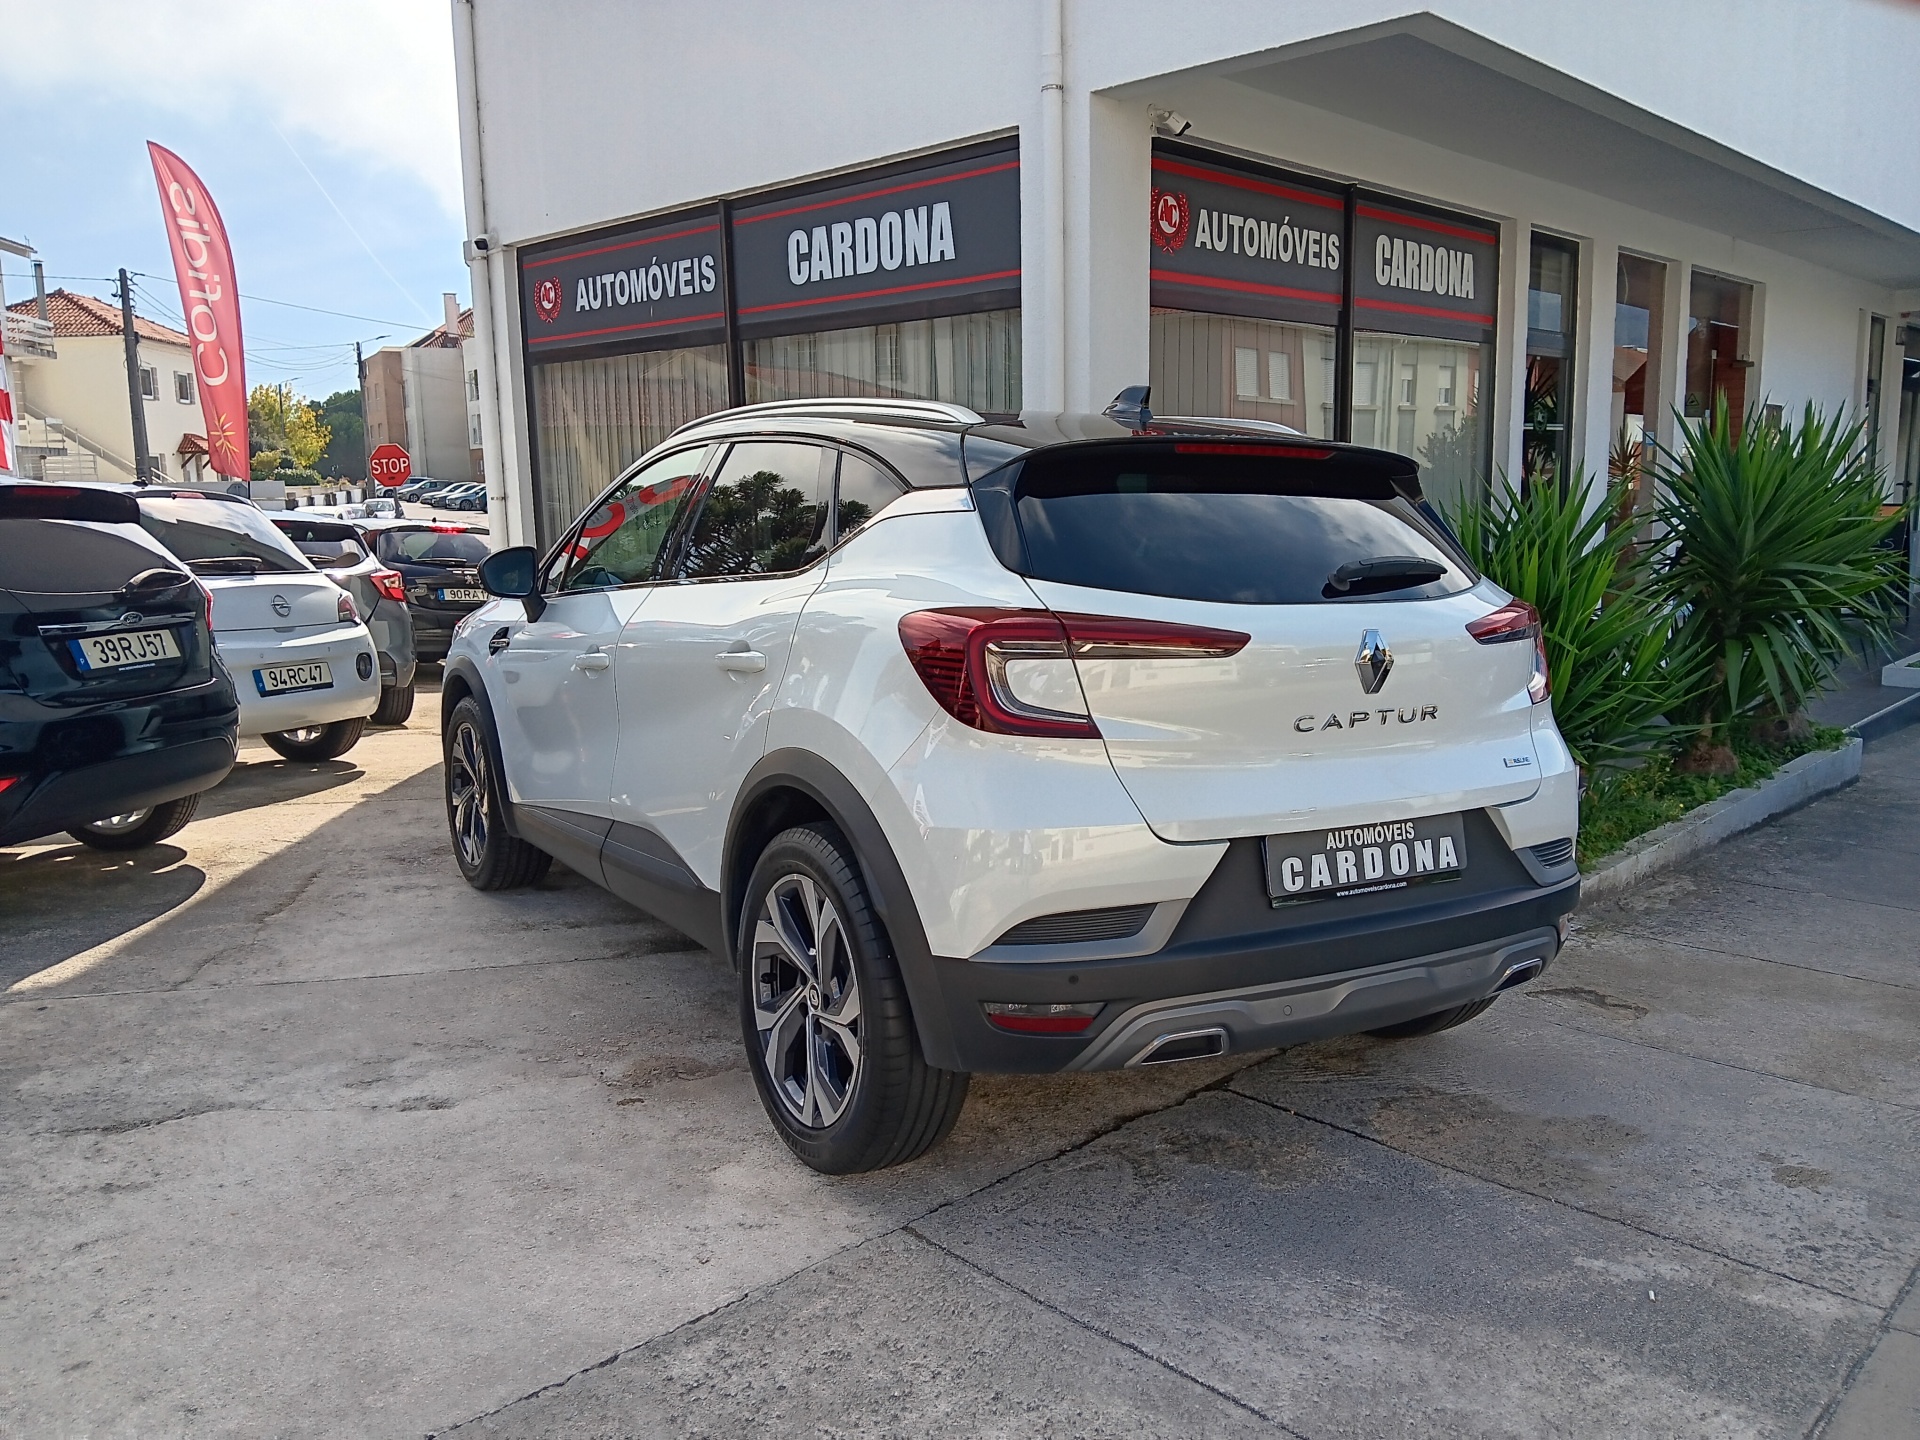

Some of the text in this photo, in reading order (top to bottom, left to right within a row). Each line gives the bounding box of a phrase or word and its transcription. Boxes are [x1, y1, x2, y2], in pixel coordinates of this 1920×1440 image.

[575, 201, 956, 312] AUTOMÓVEIS CARDONA
[1195, 208, 1475, 299] AUTOMÓVEIS CARDONA
[371, 458, 409, 474] STOP
[93, 633, 167, 664] 39RJ57
[268, 665, 322, 688] 94RC47
[1293, 703, 1439, 733] CAPTUR
[1326, 821, 1415, 850] AUTOMÓVEIS
[1281, 836, 1459, 892] CARDONA
